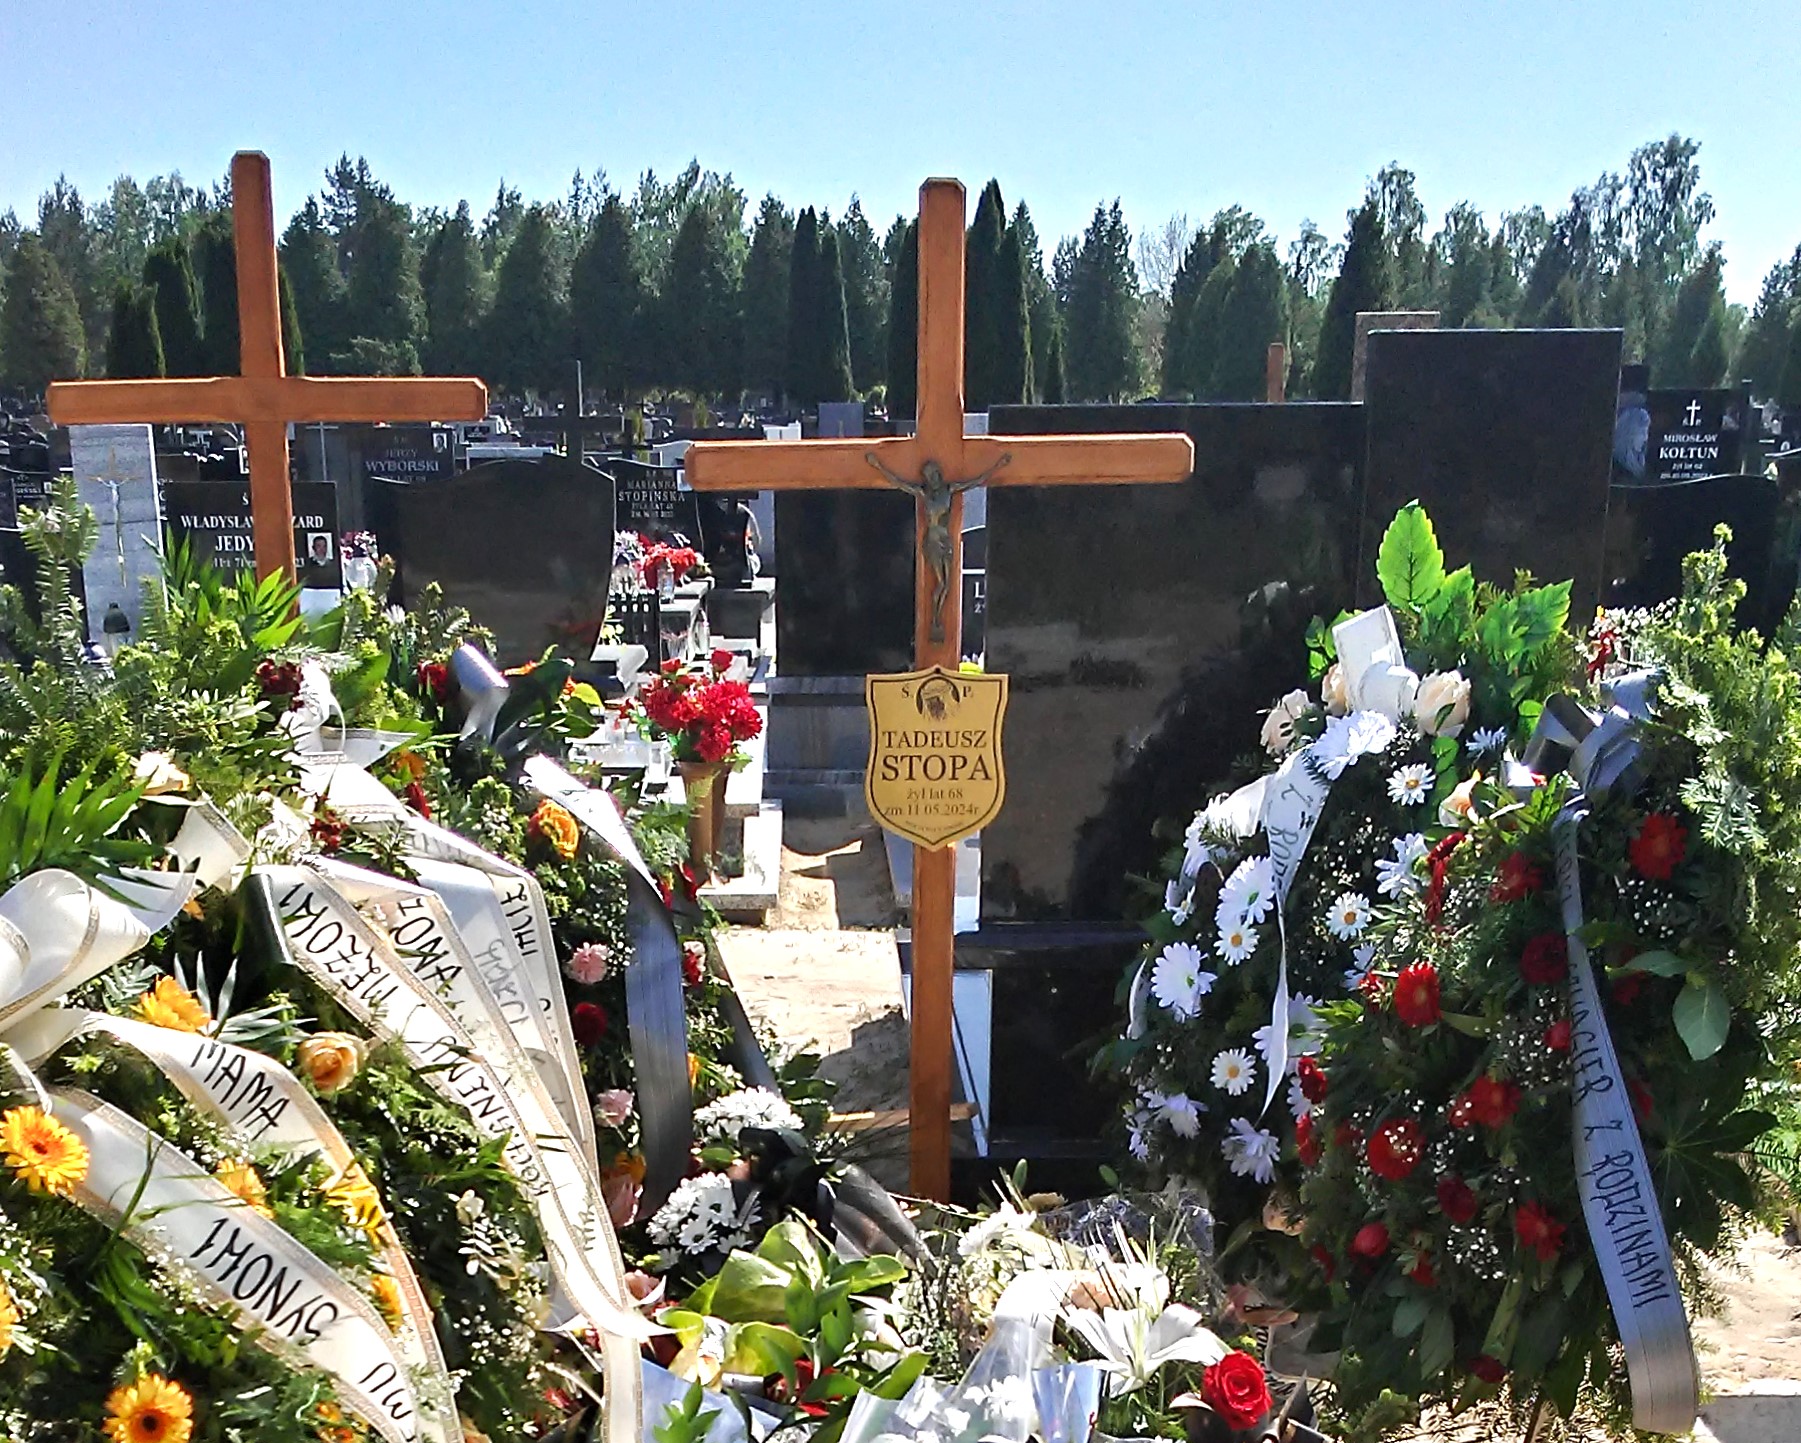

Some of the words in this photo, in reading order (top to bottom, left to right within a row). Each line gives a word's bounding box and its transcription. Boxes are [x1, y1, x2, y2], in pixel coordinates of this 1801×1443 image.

[1663, 433, 1718, 443] MIROSŁAW
[1659, 447, 1718, 459] KOŁTUN
[365, 460, 439, 472] WYBORSKI
[627, 480, 677, 490] MARIANNA
[215, 535, 256, 552] JEDY
[882, 730, 988, 749] TADEUSZ
[881, 754, 993, 782] STOPA
[906, 786, 925, 801] żył
[929, 787, 944, 800] lat
[948, 787, 963, 800] 68
[279, 882, 399, 1002] MĘŻOWI
[190, 1042, 290, 1141] MAMA
[1582, 1149, 1671, 1309] RODZINAMI
[189, 1217, 339, 1347] SYNOWI
